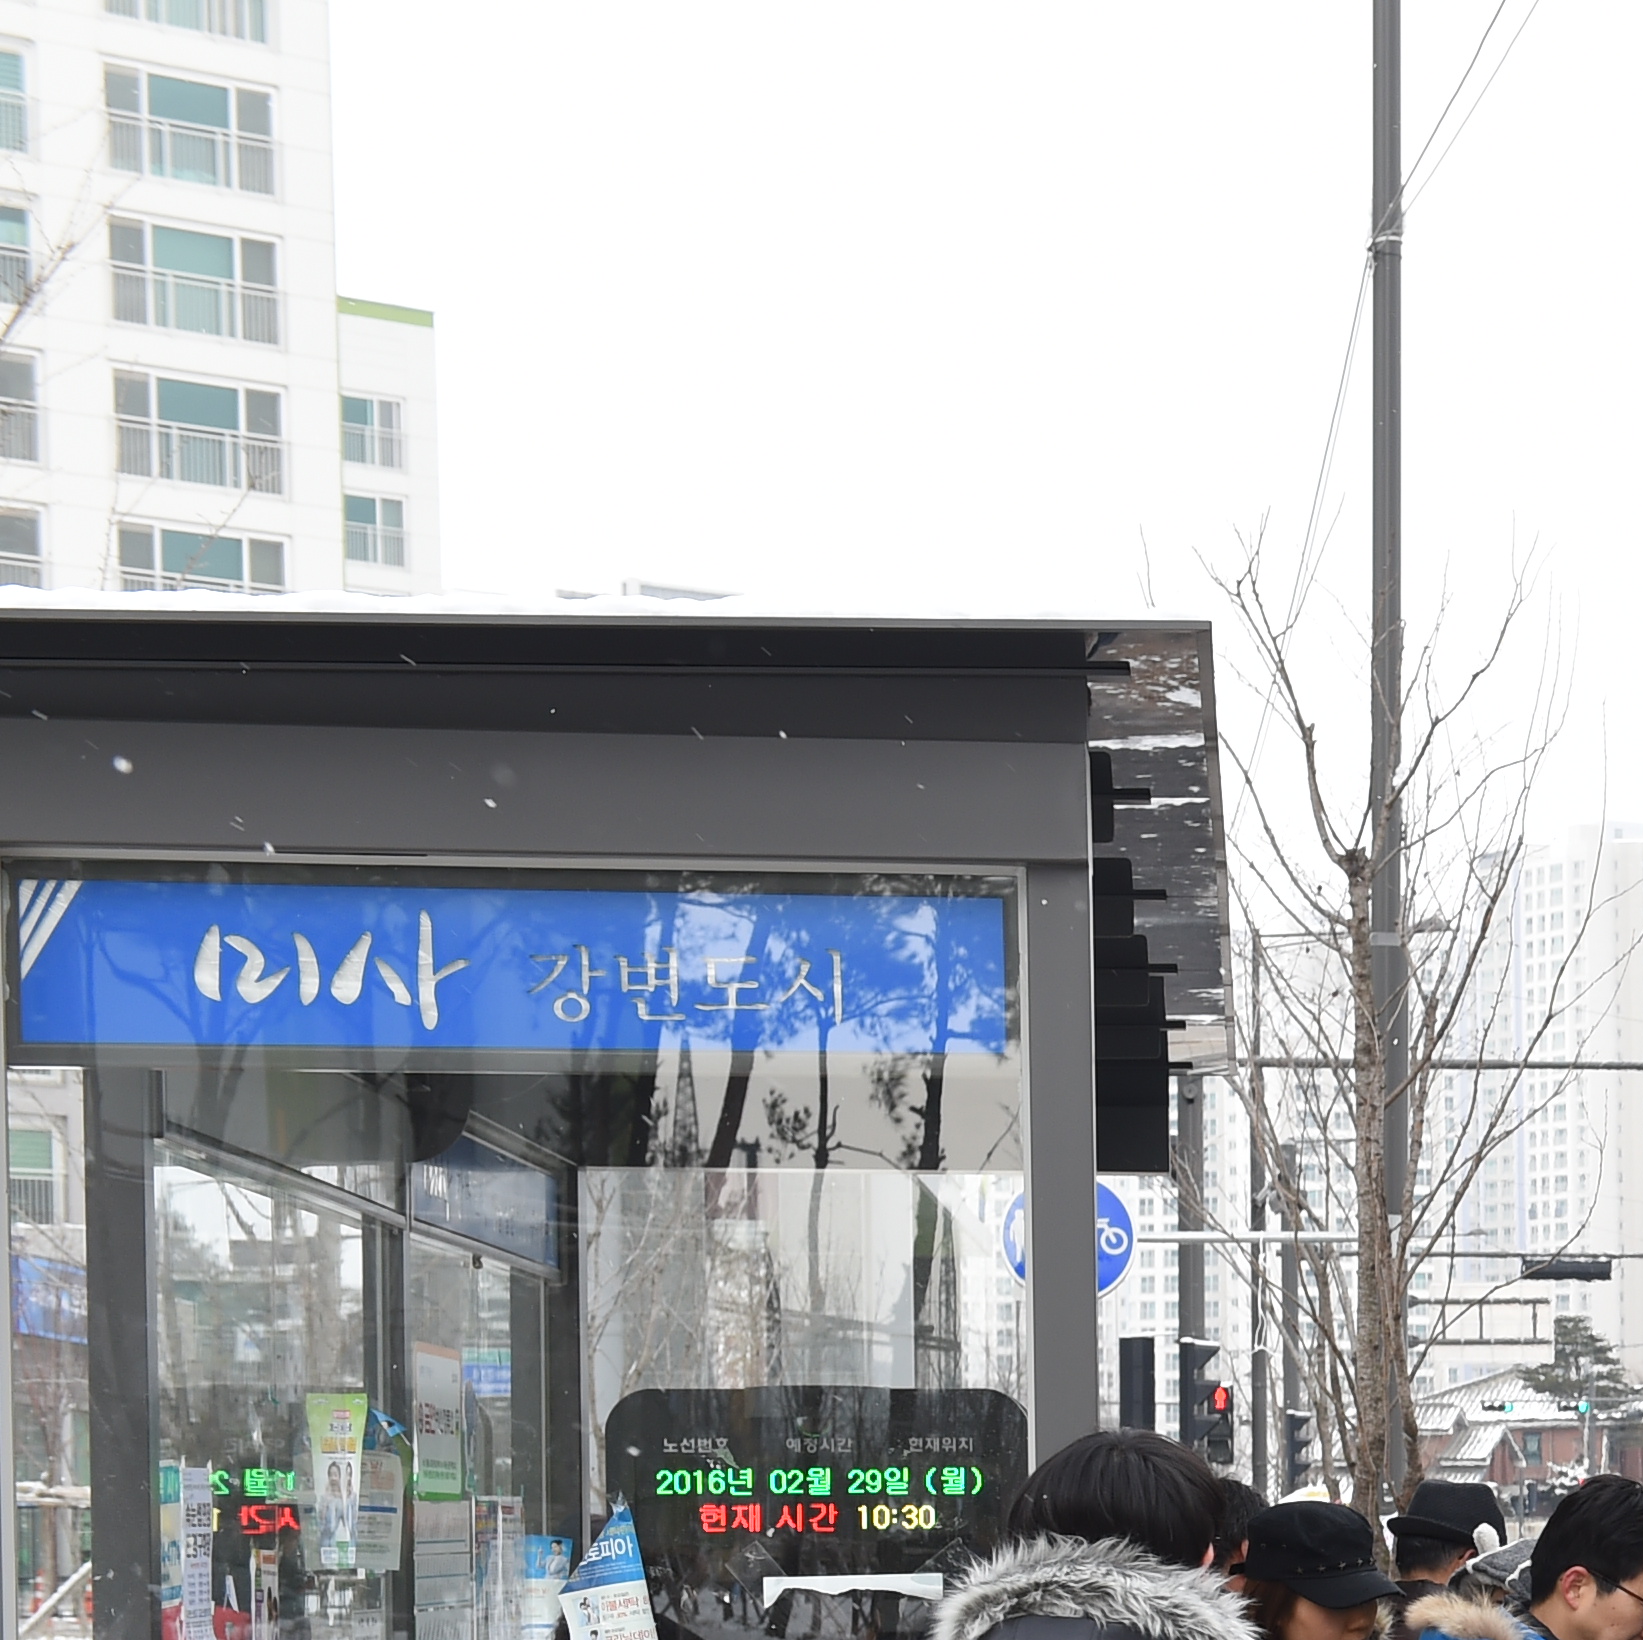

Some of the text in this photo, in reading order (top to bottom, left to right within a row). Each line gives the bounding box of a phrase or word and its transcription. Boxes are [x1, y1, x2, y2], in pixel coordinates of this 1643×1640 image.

[194, 909, 847, 1031] 미사 강변도시
[785, 1436, 853, 1454] 예정시간
[908, 1436, 974, 1453] 현재위치
[656, 1467, 753, 1496] 2016년
[769, 1467, 832, 1496] 02월
[847, 1467, 909, 1496] 29일
[699, 1502, 936, 1533] 현재 시간 10:30
